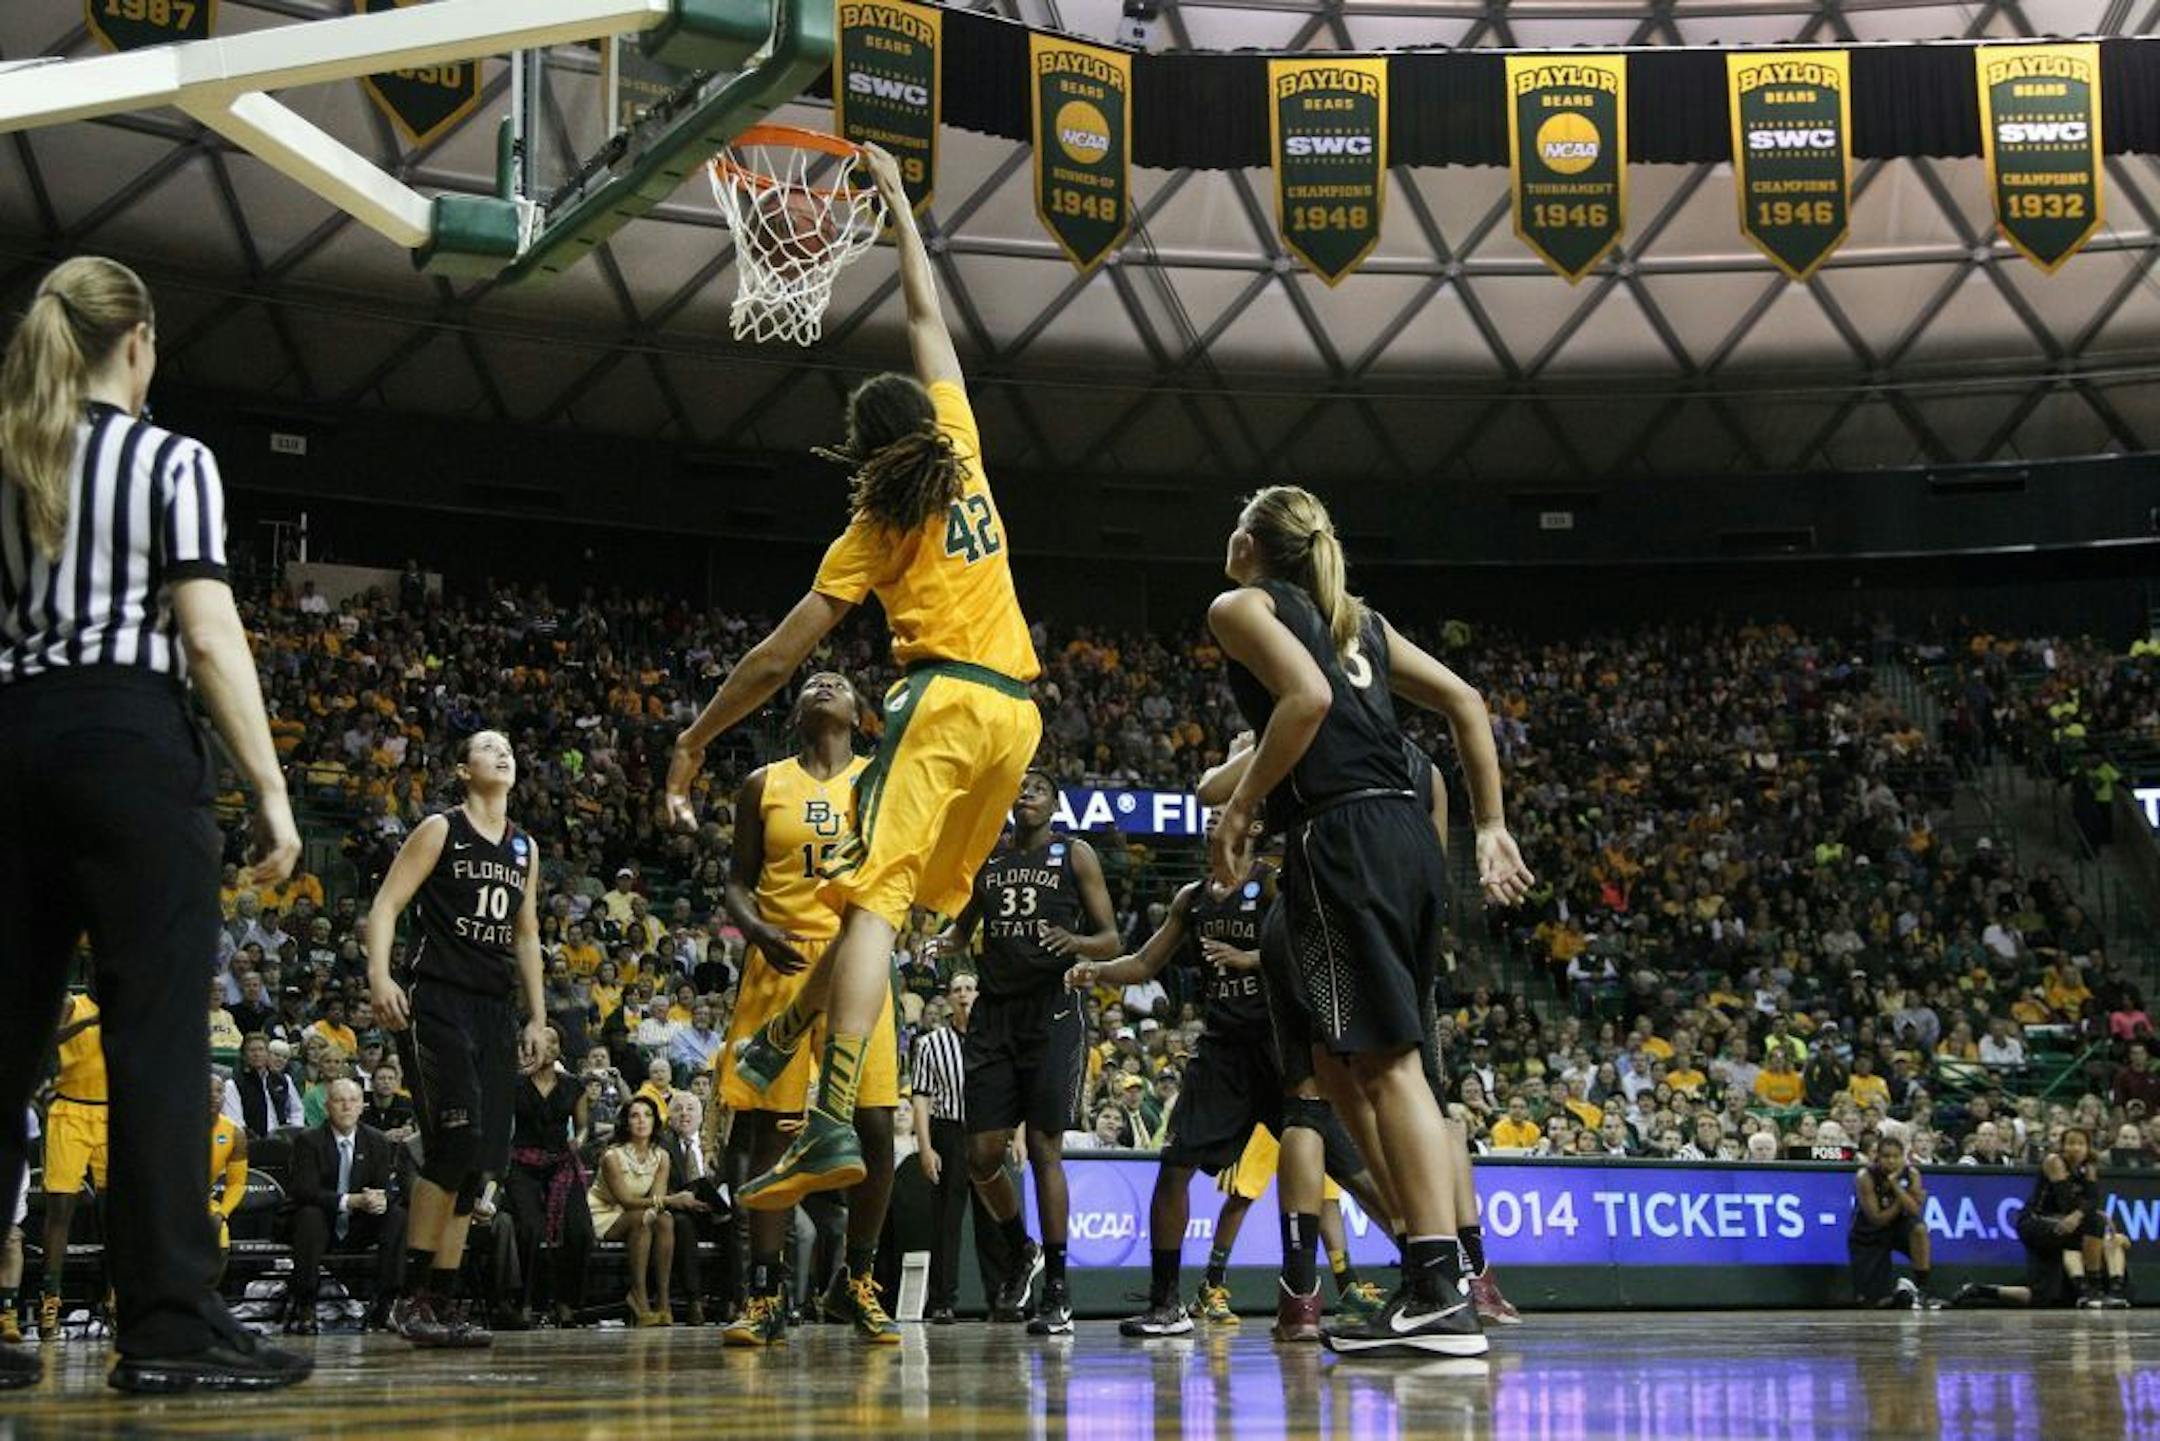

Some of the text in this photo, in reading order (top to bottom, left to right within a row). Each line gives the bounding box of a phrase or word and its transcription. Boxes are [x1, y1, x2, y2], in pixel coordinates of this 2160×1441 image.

[841, 5, 935, 48] BAYLOR
[865, 34, 912, 55] BEARS
[1039, 52, 1124, 94] BAYLOR
[1278, 69, 1379, 98] BAYLOR
[1516, 66, 1617, 95] BAYLOR
[1739, 62, 1840, 93] BAYLOR
[1988, 56, 2091, 86] BAYLOR
[849, 73, 928, 106] SWC
[1061, 80, 1104, 100] BEARS
[1541, 94, 1594, 107] BEARS
[1764, 91, 1817, 103] BEARS
[2013, 83, 2068, 97] BEARS
[1304, 98, 1355, 111] BEARS
[1062, 128, 1110, 151] NCAA
[1747, 129, 1836, 149] SWC
[1998, 122, 2088, 143] SWC
[1286, 136, 1372, 155] SWC
[1545, 142, 1599, 158] NCAA
[1287, 185, 1373, 198] CHAMPIONS
[1526, 183, 1614, 195] TOURNAMENT
[1751, 180, 1837, 193] CHAMPIONS
[2002, 172, 2089, 186] CHAMPIONS
[1052, 188, 1116, 223] 1948
[1293, 205, 1368, 231] 1948
[1534, 203, 1608, 228] 1946
[1759, 201, 1833, 226] 1946
[2008, 193, 2085, 218] 1932
[946, 494, 1000, 563] 42
[805, 800, 841, 835] BU
[985, 868, 1060, 890] FLORIDA
[474, 884, 509, 921] 10
[1000, 886, 1037, 917] 33
[1594, 1191, 1804, 1239] TICKETS
